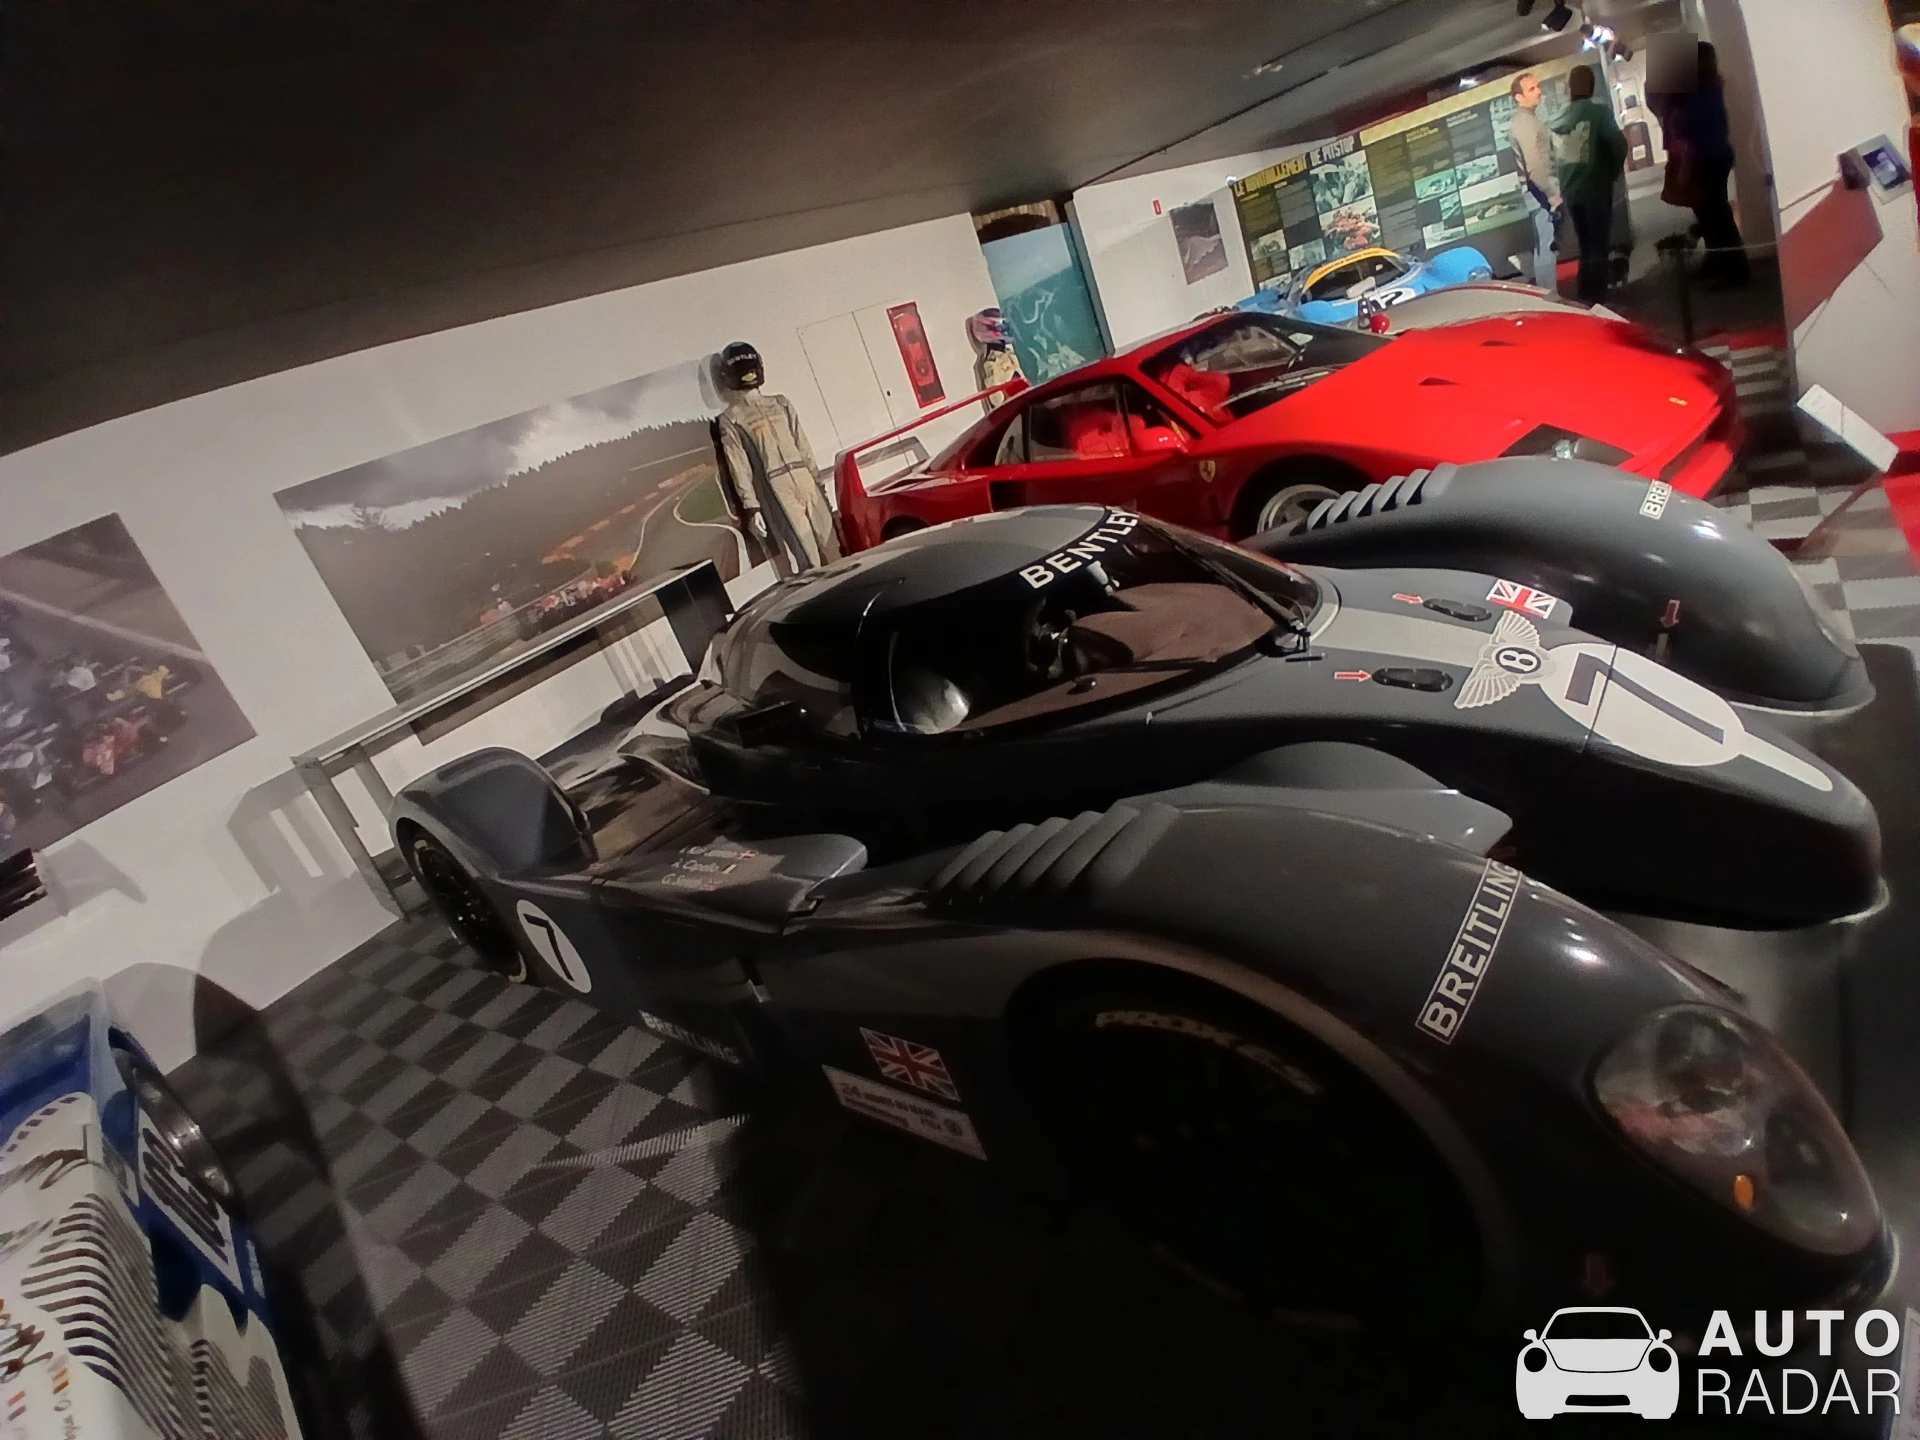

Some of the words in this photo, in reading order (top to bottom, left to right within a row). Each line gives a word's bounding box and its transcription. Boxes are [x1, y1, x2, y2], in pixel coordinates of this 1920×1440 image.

[1019, 506, 1140, 589] BENTLEY
[1565, 652, 1724, 745] 7
[523, 913, 575, 982] 7
[1422, 860, 1519, 1037] BREITLING
